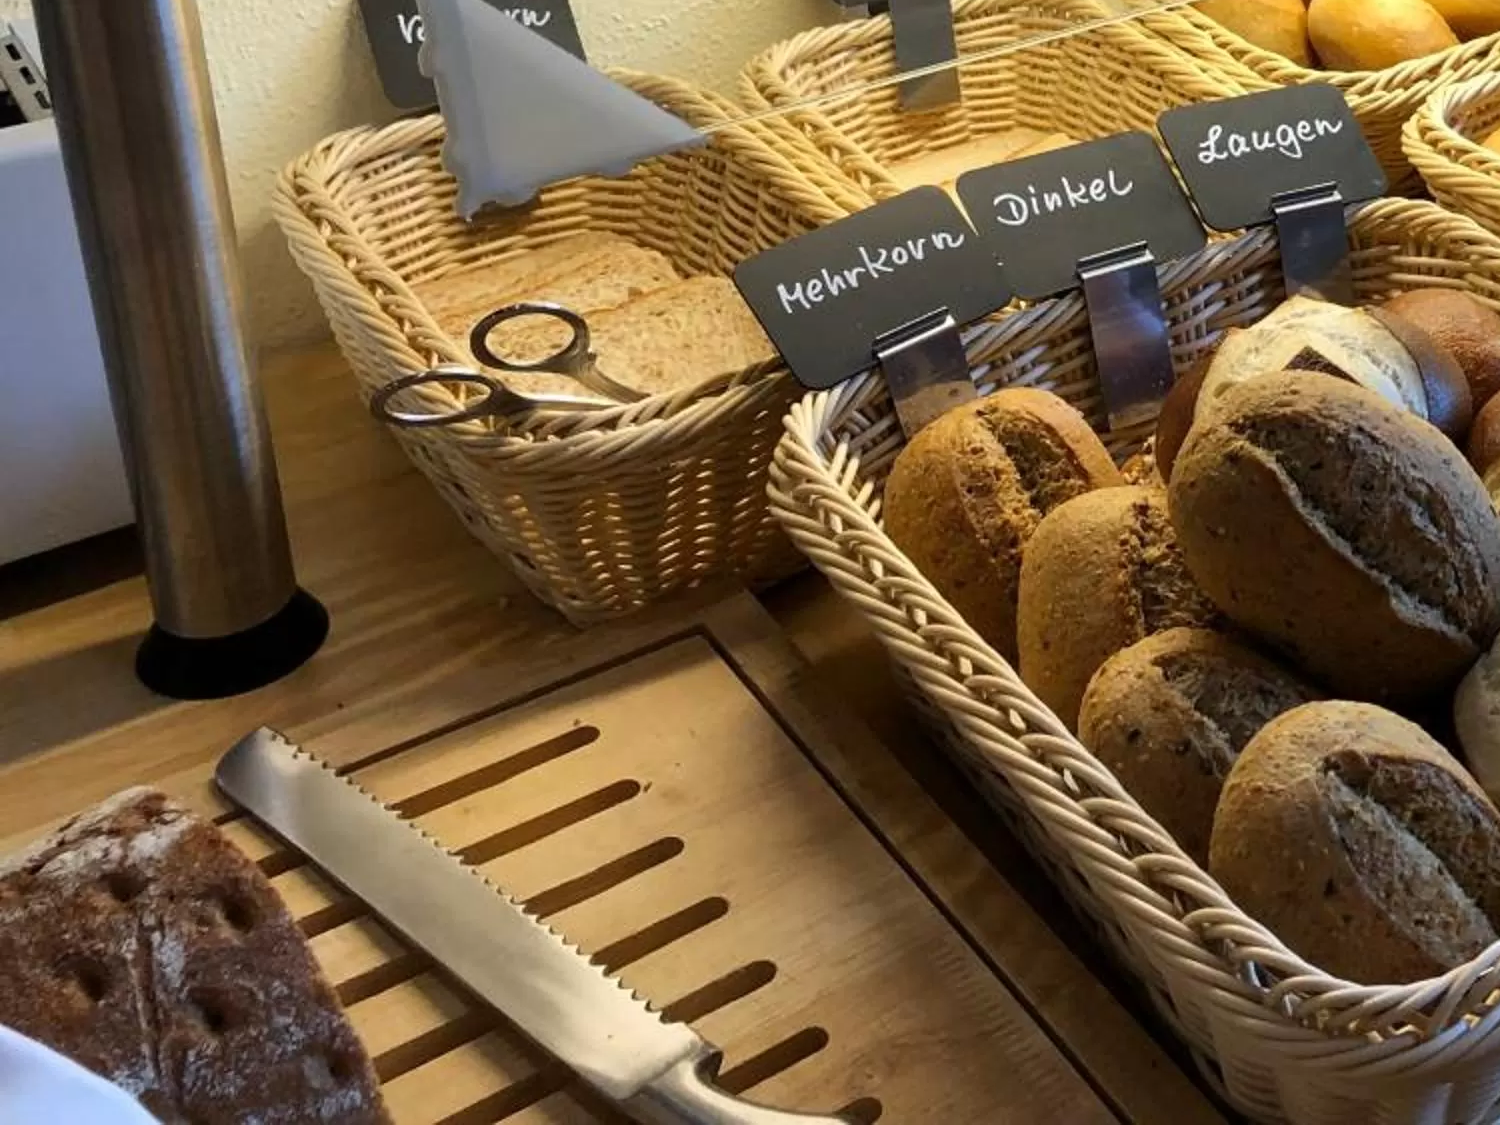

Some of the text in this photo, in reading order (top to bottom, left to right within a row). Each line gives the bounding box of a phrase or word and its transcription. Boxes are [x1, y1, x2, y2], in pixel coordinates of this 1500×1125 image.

[1198, 118, 1343, 164] Laugen
[993, 170, 1133, 226] Dinkel
[776, 231, 965, 314] Mehrkorn
